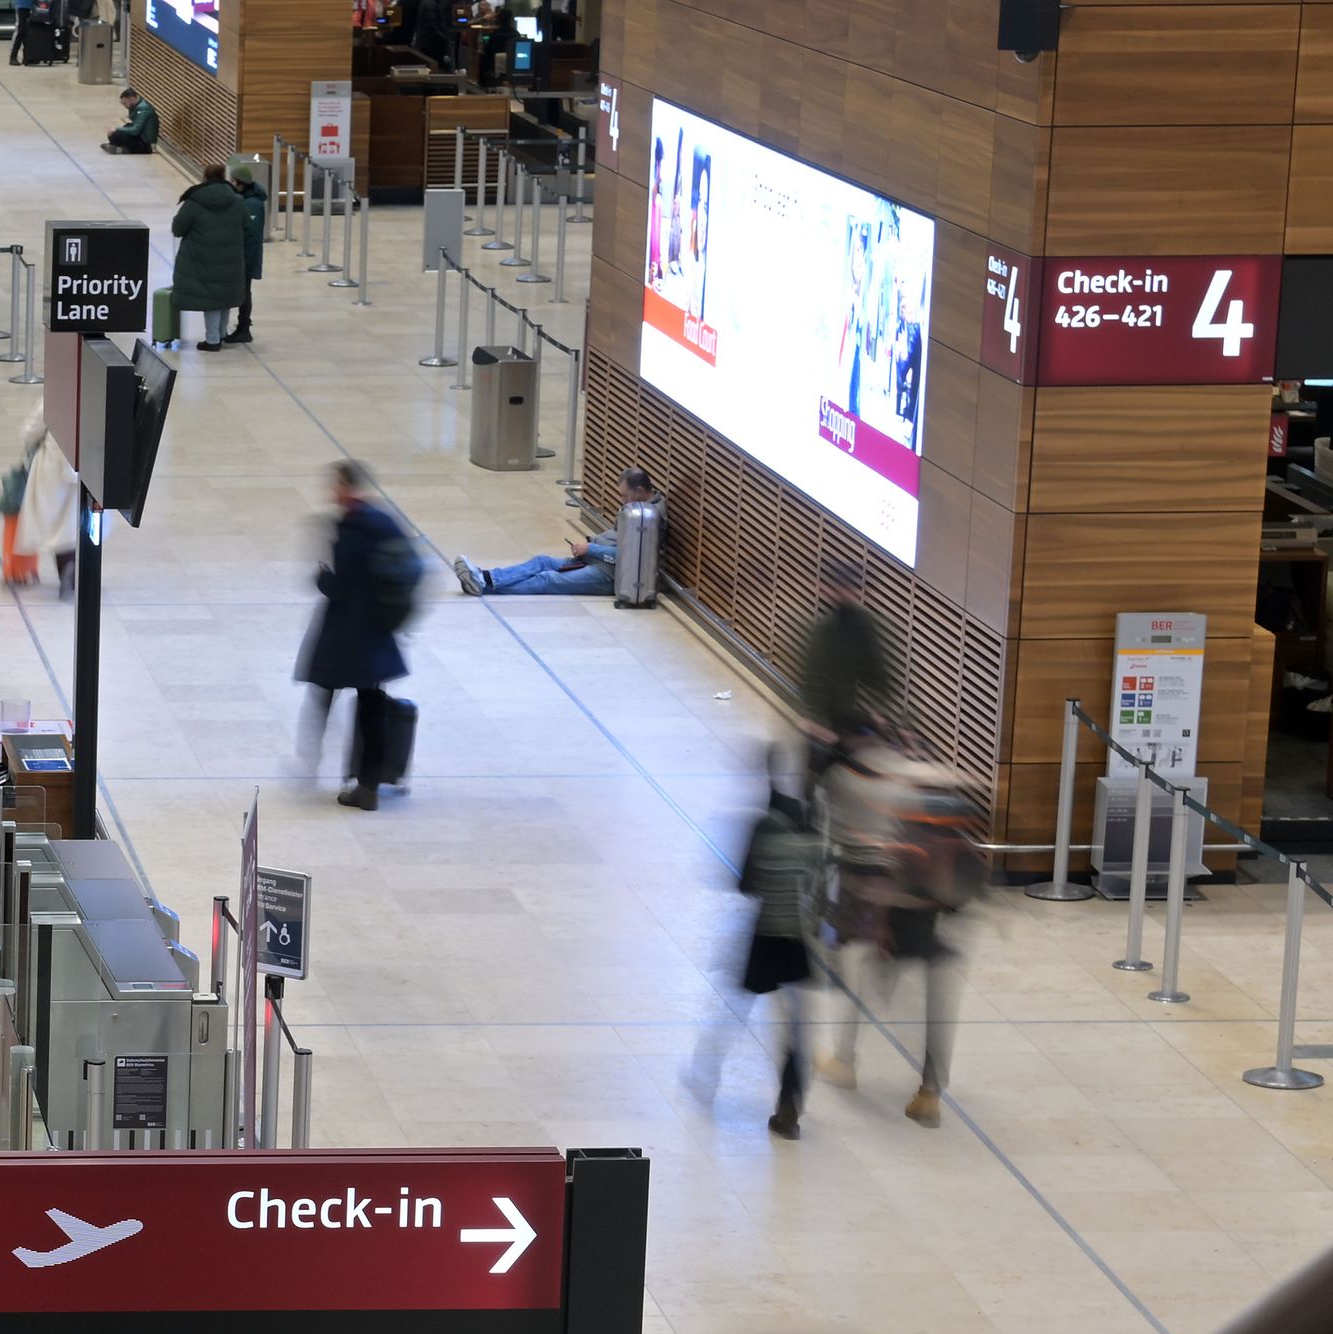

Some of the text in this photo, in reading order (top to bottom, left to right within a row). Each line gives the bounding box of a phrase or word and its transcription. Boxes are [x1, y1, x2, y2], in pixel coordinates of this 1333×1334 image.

[58, 274, 143, 301] Priority
[1057, 269, 1168, 294] Check-in
[57, 301, 109, 320] Lane
[1004, 266, 1021, 353] 4
[1191, 270, 1254, 357] 4
[1151, 621, 1173, 631] BER
[228, 1187, 442, 1230] Check-in
